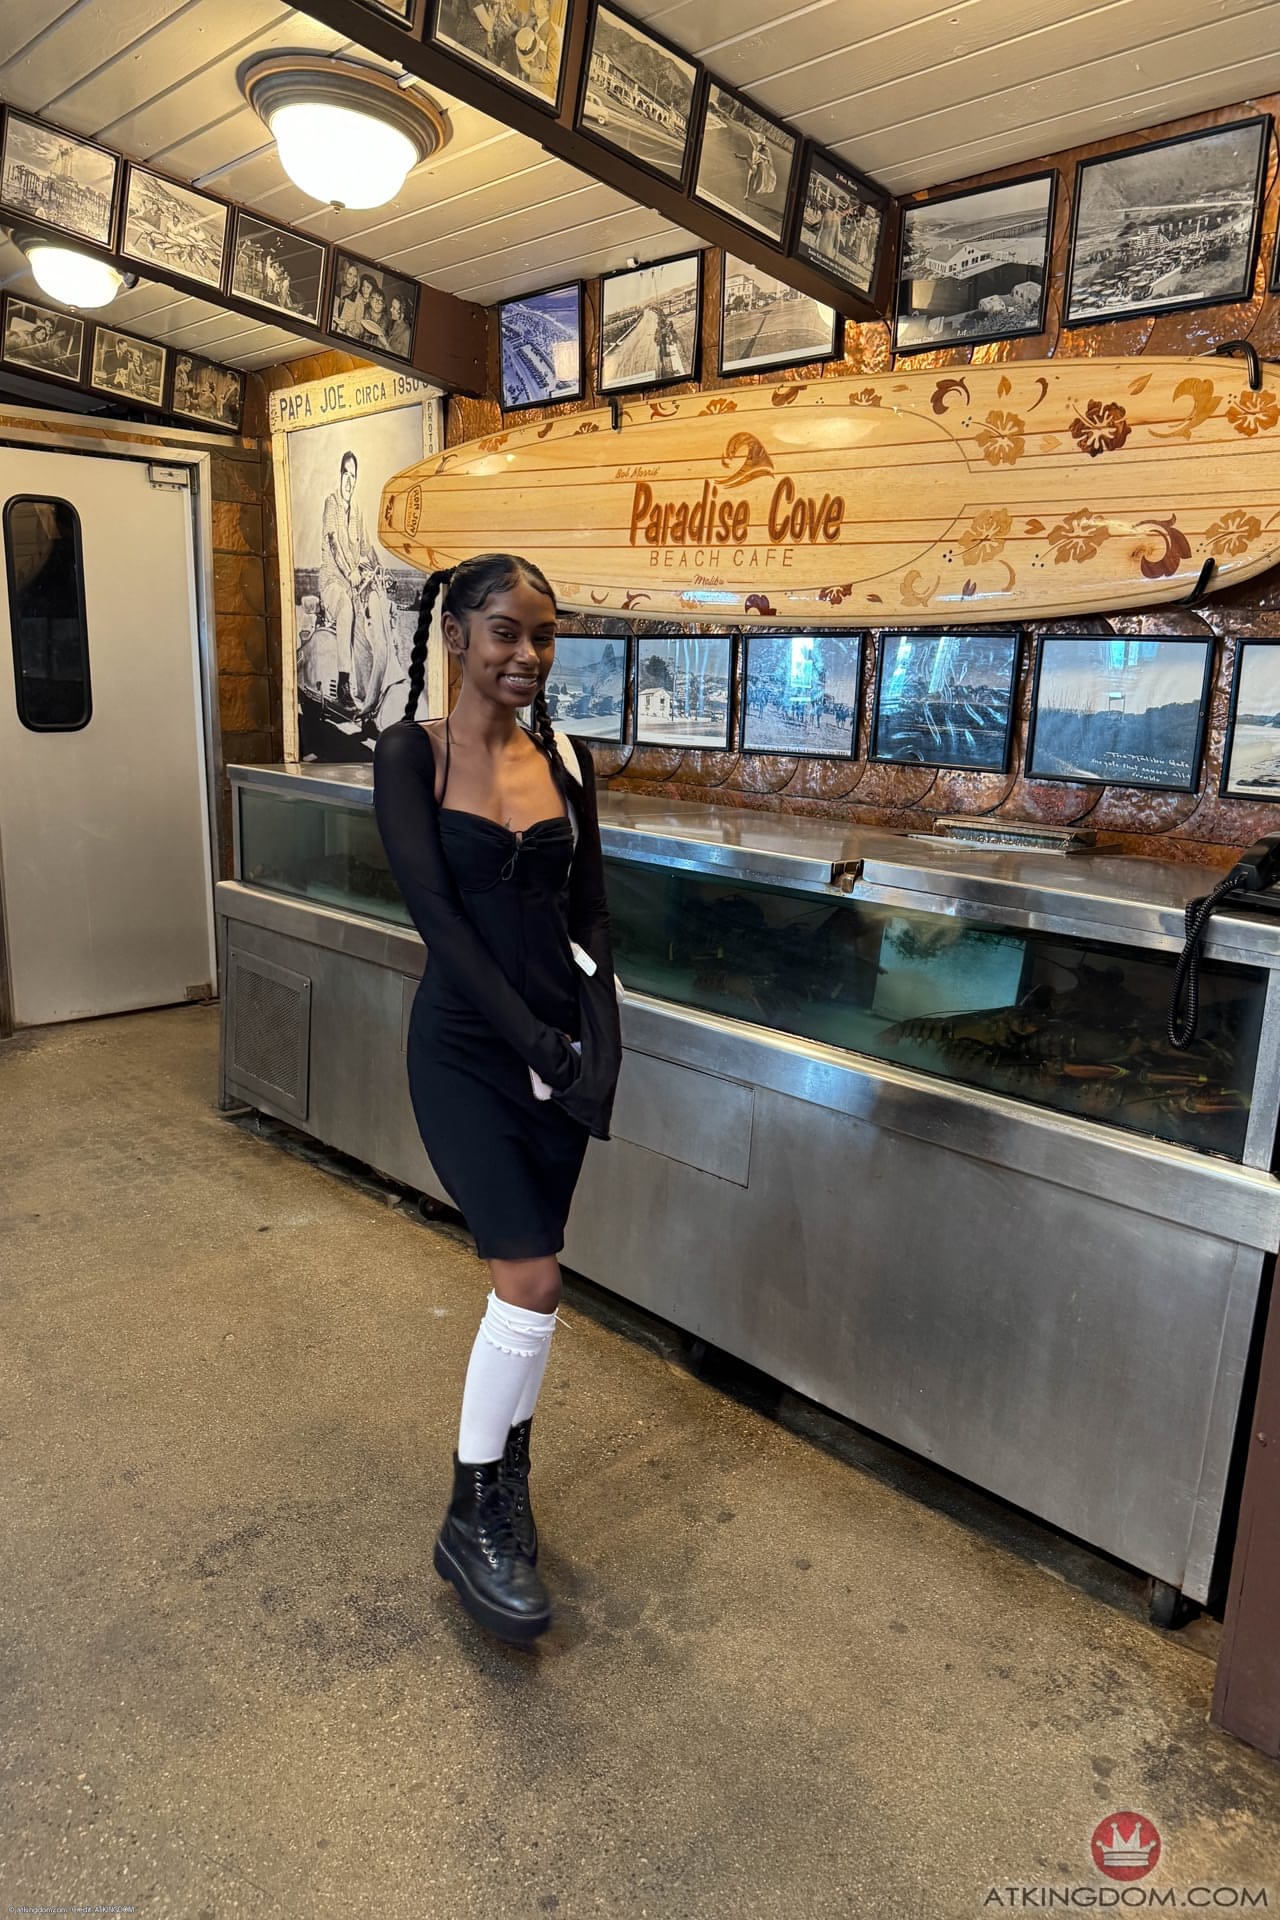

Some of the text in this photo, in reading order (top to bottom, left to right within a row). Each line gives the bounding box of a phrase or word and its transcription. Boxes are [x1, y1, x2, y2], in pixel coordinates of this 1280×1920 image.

[279, 394, 312, 423] PAPA
[320, 384, 352, 413] JOE.
[355, 382, 387, 406] CIRCA
[629, 475, 846, 547] Paradise Cove
[649, 548, 795, 568] BEACH CAFE
